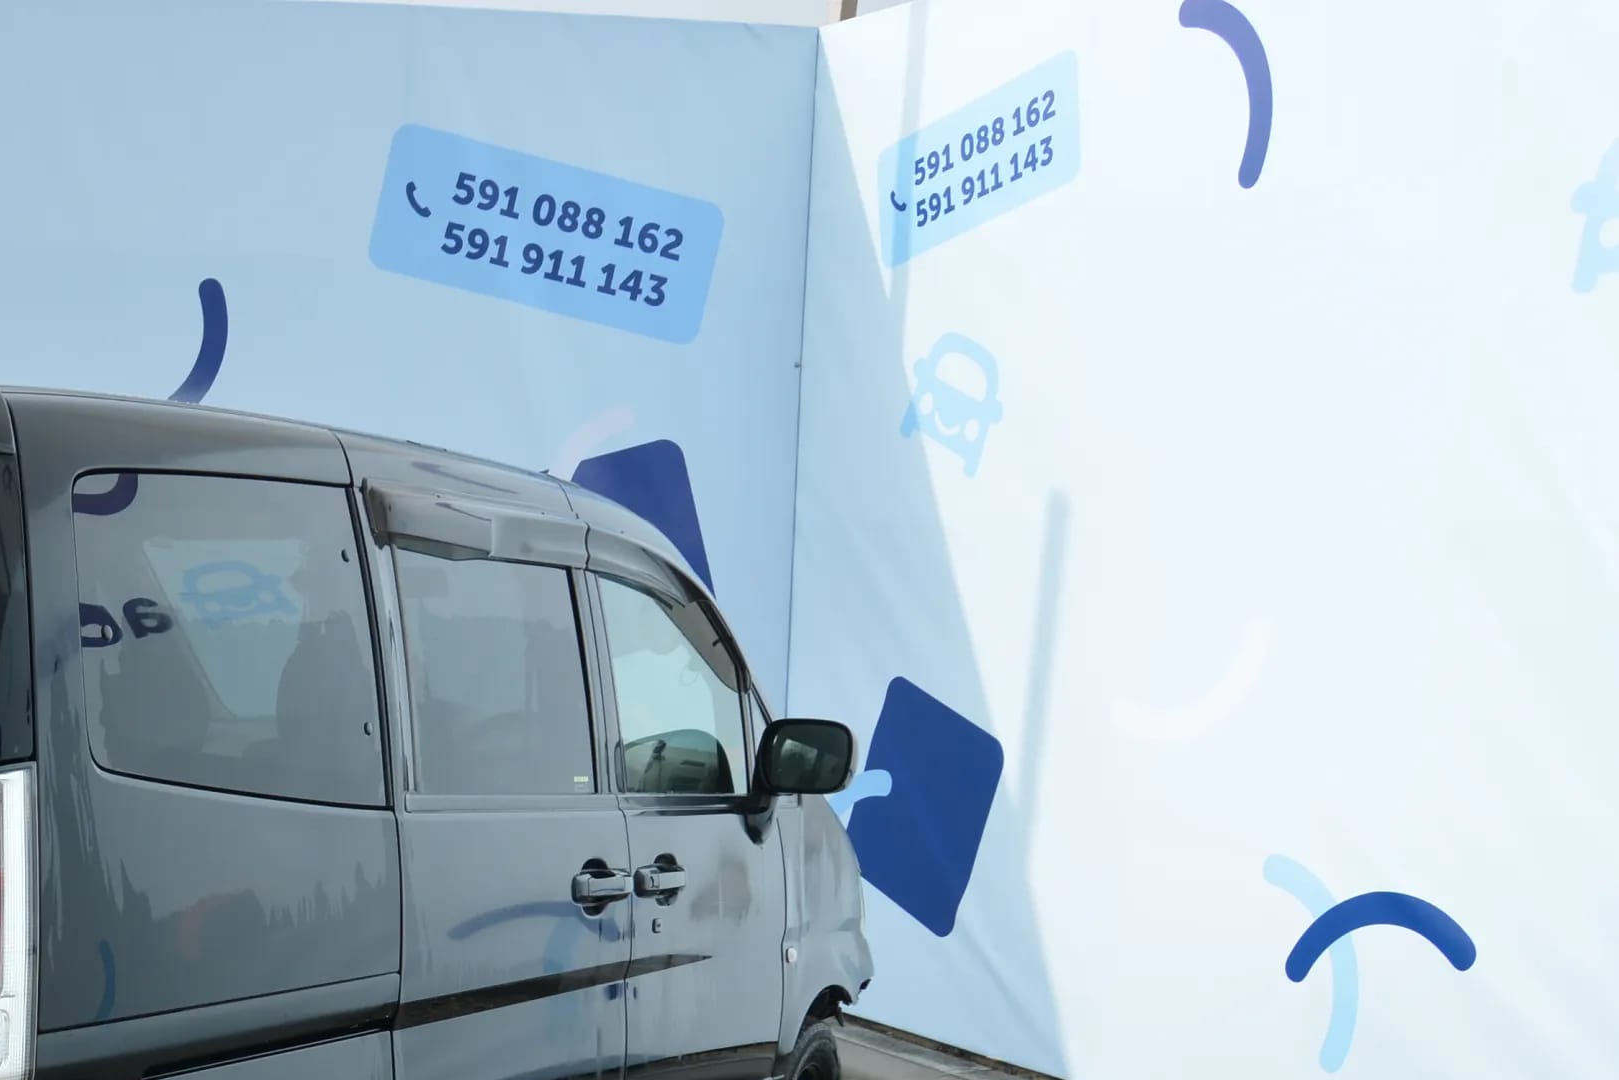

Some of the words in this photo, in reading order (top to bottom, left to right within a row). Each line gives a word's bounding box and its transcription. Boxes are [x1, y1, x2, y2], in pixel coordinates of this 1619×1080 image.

[914, 143, 954, 186] 591
[960, 116, 1005, 162] 088
[1012, 89, 1057, 136] 162
[915, 185, 955, 228] 591
[961, 162, 1003, 205] 911
[1009, 135, 1054, 182] 143
[451, 171, 519, 219] 591
[532, 193, 606, 239] 088
[613, 215, 683, 261] 162
[440, 221, 509, 268] 591
[520, 242, 586, 288] 911
[596, 263, 668, 307] 143
